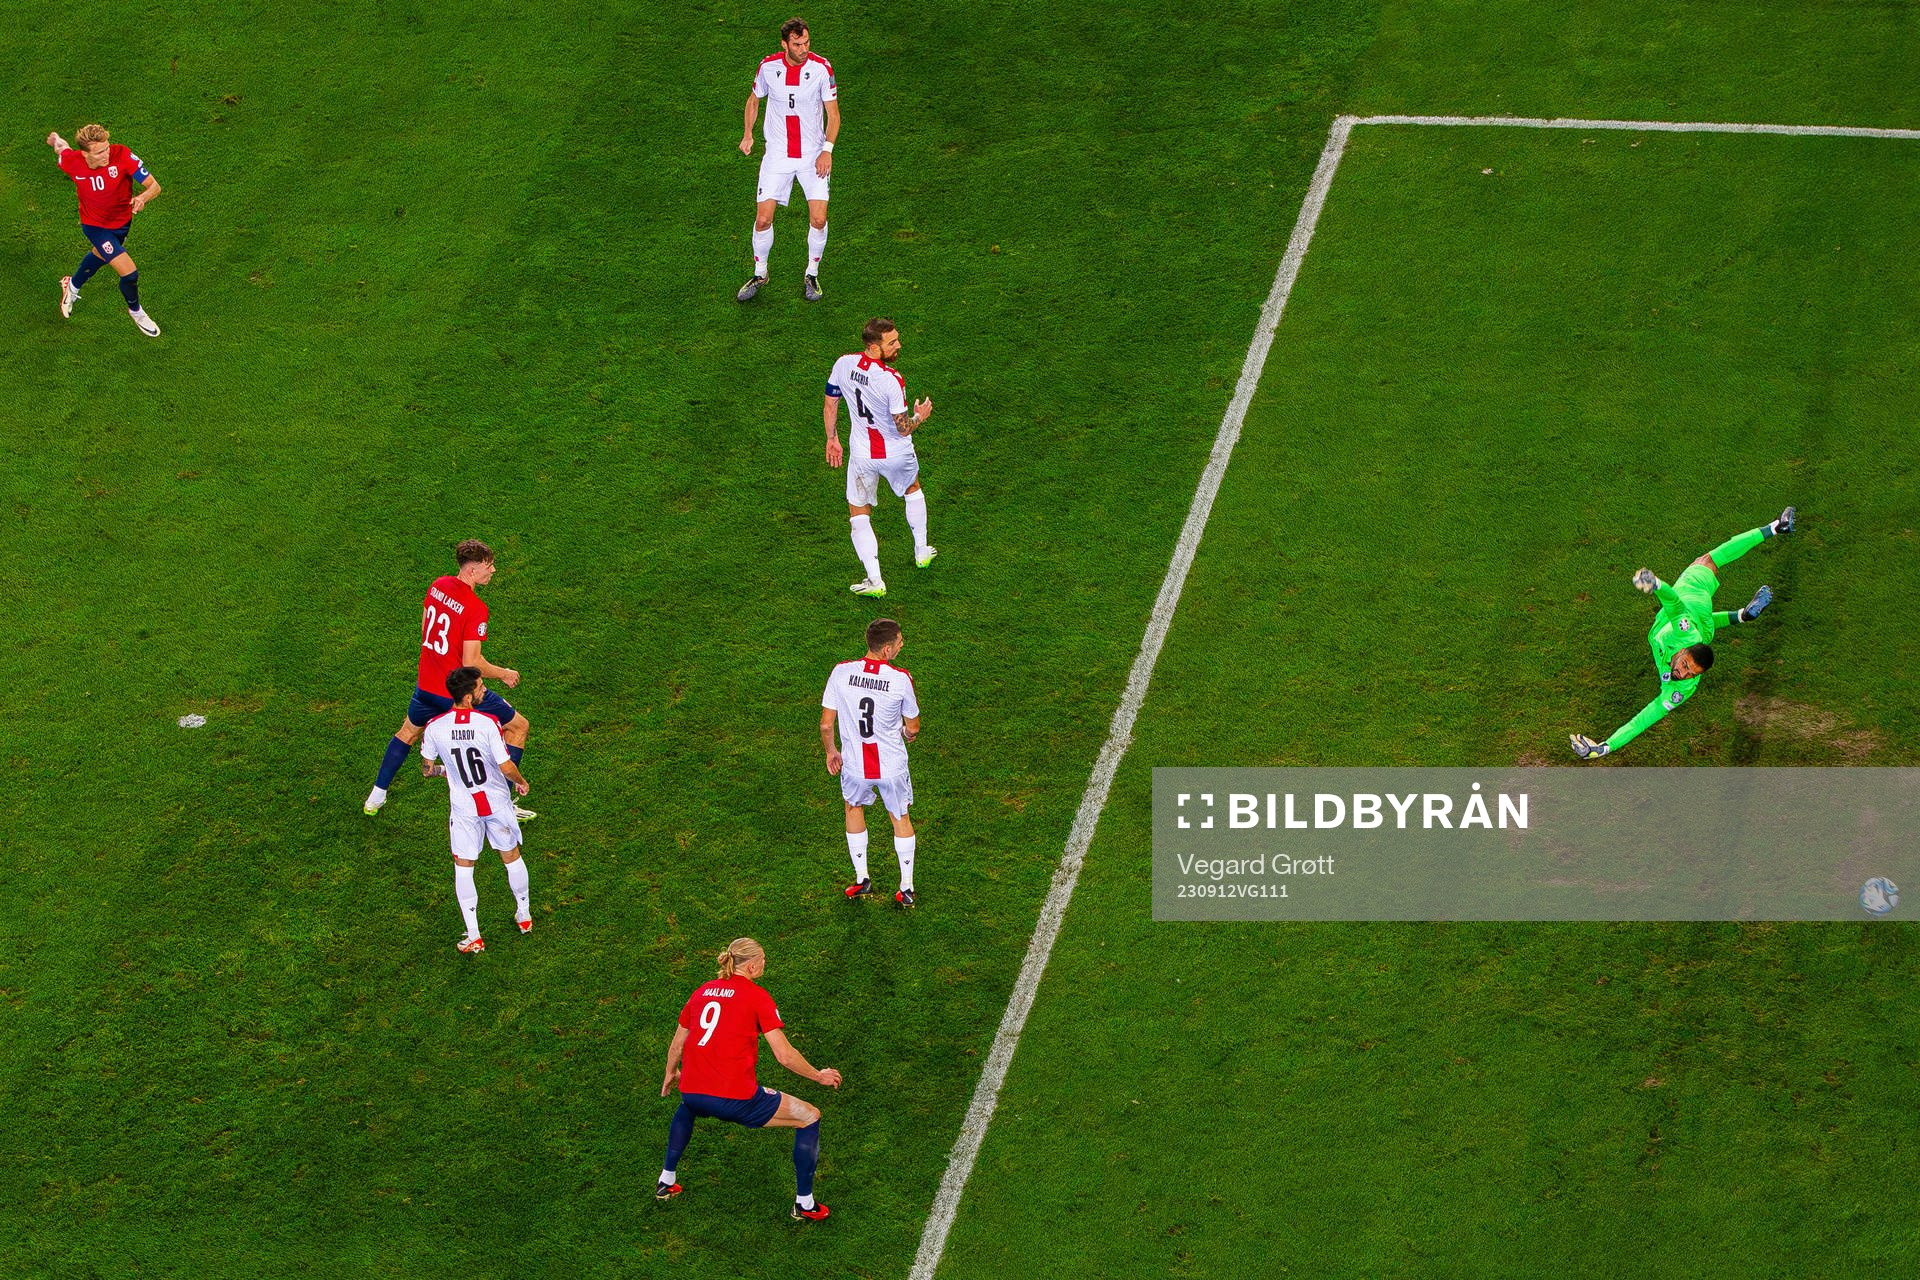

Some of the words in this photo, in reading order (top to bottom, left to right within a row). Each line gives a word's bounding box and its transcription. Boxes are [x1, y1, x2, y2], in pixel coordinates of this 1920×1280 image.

[788, 93, 796, 109] 5
[89, 175, 105, 191] 10
[855, 388, 875, 425] 4
[443, 595, 465, 616] LARSEN
[422, 604, 451, 656] 23
[848, 674, 890, 692] KALANDADZE
[858, 696, 875, 738] 3
[451, 729, 475, 741] AZAROV
[450, 747, 488, 789] 16
[702, 987, 735, 998] HAALAND
[697, 1001, 721, 1047] 9
